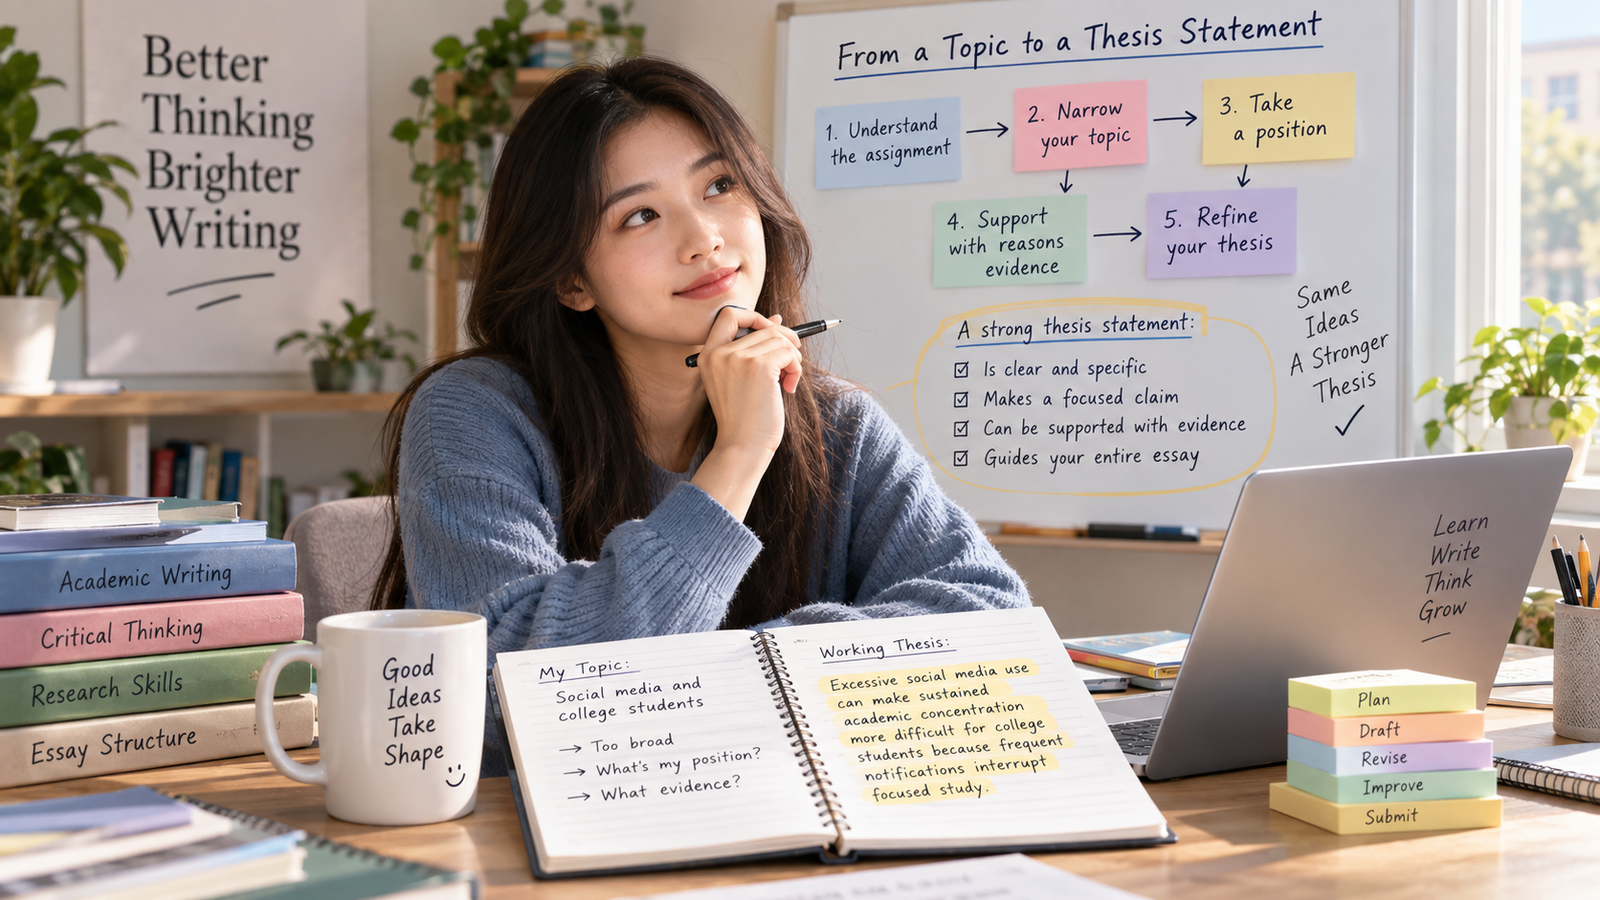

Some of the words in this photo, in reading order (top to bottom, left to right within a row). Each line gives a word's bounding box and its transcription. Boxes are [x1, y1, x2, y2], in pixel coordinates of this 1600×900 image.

[838, 41, 900, 71] From
[914, 46, 929, 62] a
[943, 32, 1009, 72] Topic
[1022, 31, 1044, 54] to
[1056, 36, 1071, 51] a
[1083, 22, 1163, 51] Thesis
[1179, 10, 1323, 45] Statement
[145, 34, 269, 83] Better
[1027, 105, 1045, 124] 2.
[1057, 101, 1123, 121] Narrow
[1219, 96, 1237, 116] 3.
[1249, 91, 1294, 114] Take
[142, 93, 314, 151] Thinking
[826, 123, 838, 142] 1.
[849, 112, 938, 139] Understand
[1233, 129, 1245, 141] a
[1256, 119, 1327, 149] position
[830, 147, 857, 166] the
[865, 137, 952, 168] assignment
[1041, 134, 1079, 158] your
[1088, 126, 1131, 152] topic
[148, 149, 300, 204] Brighter
[947, 212, 964, 231] 4.
[977, 206, 1048, 235] Support
[1164, 209, 1182, 229] 5.
[1197, 204, 1259, 228] Refine
[147, 206, 300, 261] Writing
[949, 235, 987, 256] with
[999, 236, 1064, 252] reasons
[1166, 241, 1207, 266] your
[1217, 232, 1273, 254] thesis
[985, 257, 1060, 278] evidence
[1297, 280, 1352, 309] Same
[957, 320, 970, 341] A
[981, 320, 1033, 347] strong
[1043, 315, 1092, 335] thesis
[1102, 312, 1194, 333] statement:
[1305, 308, 1359, 339] Ideas
[1290, 352, 1304, 377] A
[1312, 333, 1389, 369] Stronger
[984, 361, 996, 377] Is
[1004, 359, 1043, 377] clear
[1051, 358, 1079, 376] and
[1087, 356, 1147, 383] specific
[983, 389, 1032, 407] Makes
[1042, 395, 1053, 406] a
[1062, 387, 1124, 409] focused
[1134, 386, 1179, 405] claim
[1312, 370, 1376, 403] Thesis
[983, 419, 1012, 436] Can
[1021, 418, 1039, 436] be
[1048, 416, 1125, 442] supported
[1134, 415, 1168, 433] with
[1178, 413, 1247, 433] evidence
[984, 447, 1038, 469] Guides
[1049, 453, 1085, 475] your
[1094, 447, 1142, 465] entire
[1153, 450, 1200, 472] essay
[1433, 514, 1489, 537] Learn
[1431, 540, 1481, 566] Write
[58, 567, 151, 593] Academic
[161, 563, 232, 591] Writing
[1424, 567, 1473, 595] Think
[1419, 599, 1468, 624] Grow
[40, 621, 112, 650] Critical
[123, 616, 203, 645] Thinking
[819, 643, 885, 660] Working
[892, 638, 950, 652] Thesis:
[382, 653, 434, 684] Good
[539, 666, 565, 684] My
[575, 661, 633, 679] Topic:
[830, 676, 899, 692] Excessive
[906, 668, 947, 684] social
[954, 664, 998, 679] media
[1004, 664, 1030, 675] use
[31, 676, 120, 708] Research
[131, 670, 183, 696] Skills
[387, 685, 441, 710] Ideas
[556, 686, 605, 704] Social
[615, 681, 663, 697] media
[672, 675, 702, 691] and
[837, 699, 864, 709] can
[872, 691, 911, 706] make
[919, 683, 990, 702] sustained
[1358, 691, 1391, 709] Plan
[558, 706, 617, 723] college
[628, 696, 704, 715] students
[844, 711, 912, 726] academic
[920, 701, 1025, 720] concentration
[388, 712, 436, 738] Take
[850, 734, 886, 745] more
[894, 724, 955, 741] difficult
[963, 721, 986, 736] for
[995, 718, 1045, 735] college
[1360, 720, 1401, 739] Draft
[31, 740, 89, 769] Essay
[100, 728, 197, 756] Structure
[384, 742, 444, 771] Shape
[590, 739, 619, 753] Too
[629, 732, 674, 749] broad
[857, 747, 924, 763] students
[931, 743, 991, 757] because
[999, 734, 1063, 753] frequent
[596, 760, 649, 777] What's
[659, 760, 681, 775] my
[692, 746, 761, 771] position?
[864, 764, 965, 781] notifications
[975, 754, 1047, 774] interrupt
[1361, 750, 1408, 767] Revise
[600, 785, 647, 801] What
[660, 774, 741, 796] evidence?
[872, 783, 931, 803] focused
[939, 780, 989, 799] study.
[1363, 779, 1424, 799] Improve
[1365, 807, 1419, 826] Submit
